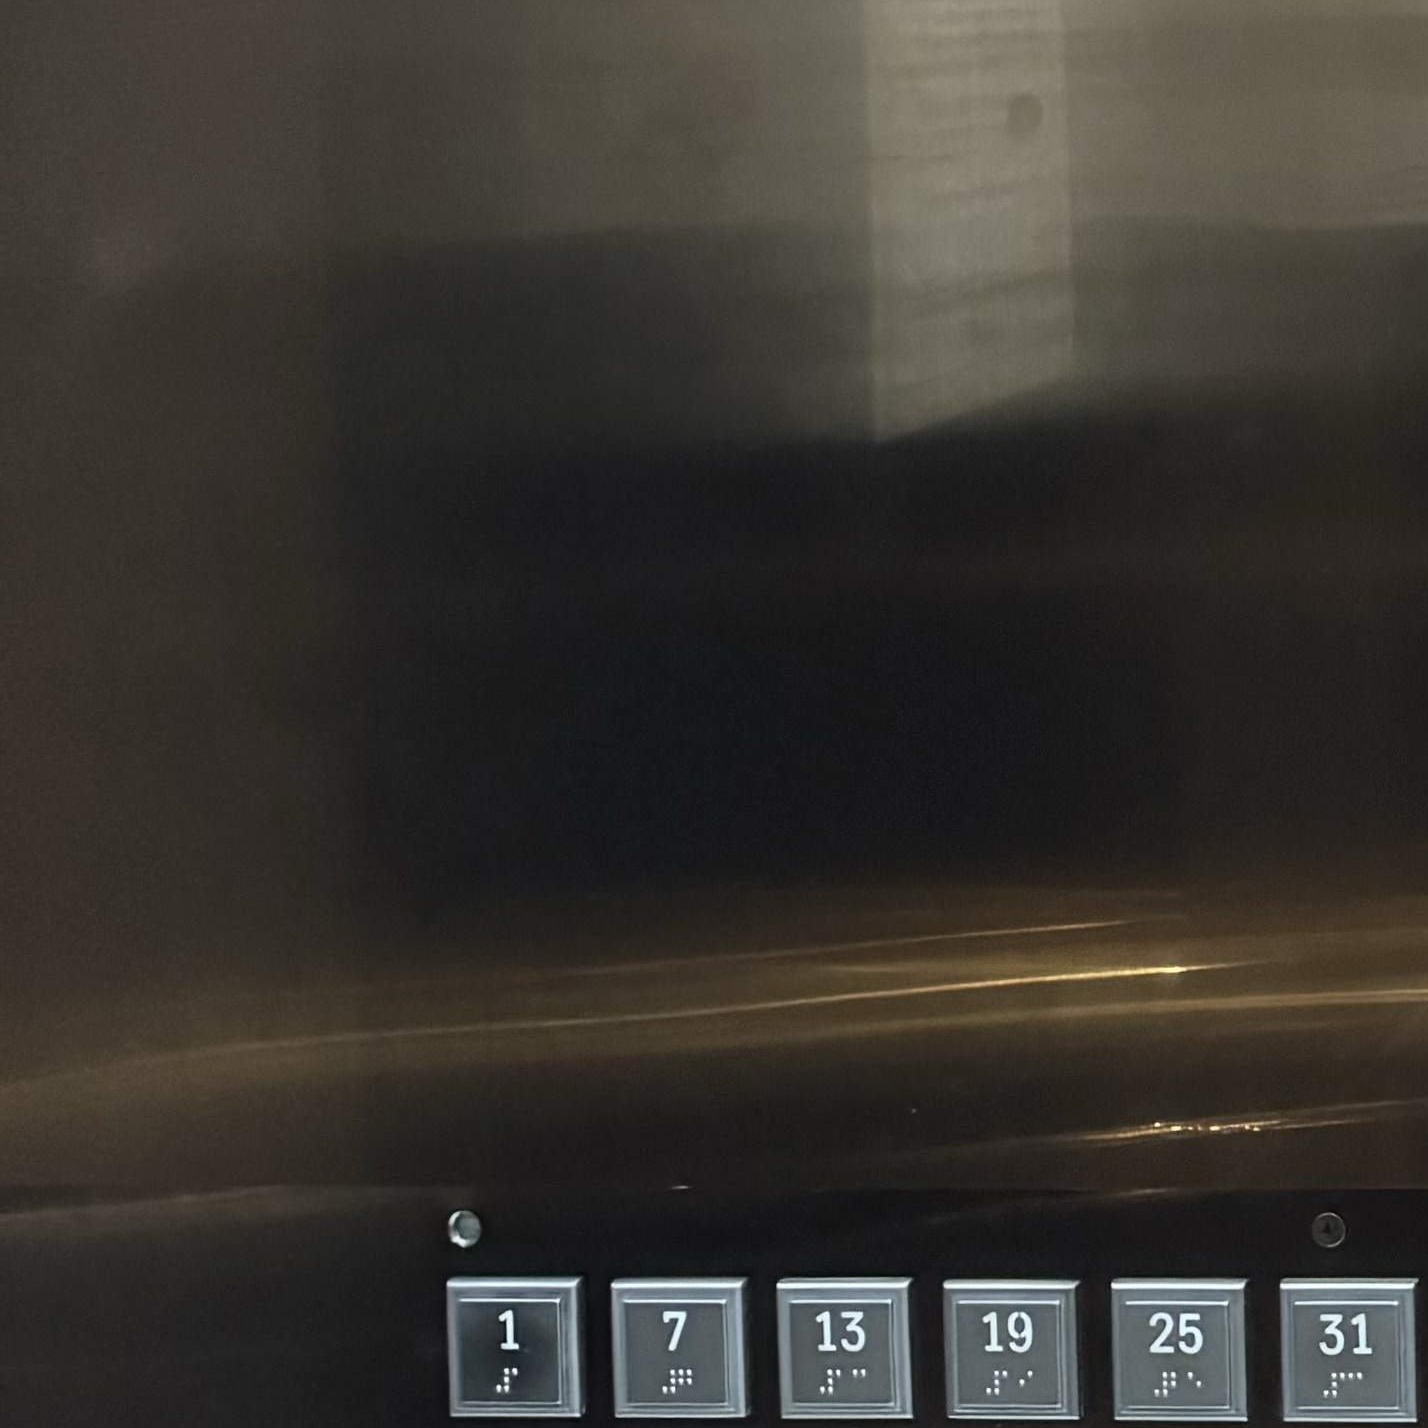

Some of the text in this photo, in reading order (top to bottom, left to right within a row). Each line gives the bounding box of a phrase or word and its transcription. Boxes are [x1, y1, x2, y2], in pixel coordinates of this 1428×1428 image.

[499, 1310, 519, 1349] 1
[663, 1311, 686, 1351] 7
[816, 1311, 865, 1351] 13
[983, 1312, 1032, 1353] 19
[1150, 1312, 1203, 1354] 25
[1319, 1314, 1372, 1355] 31
